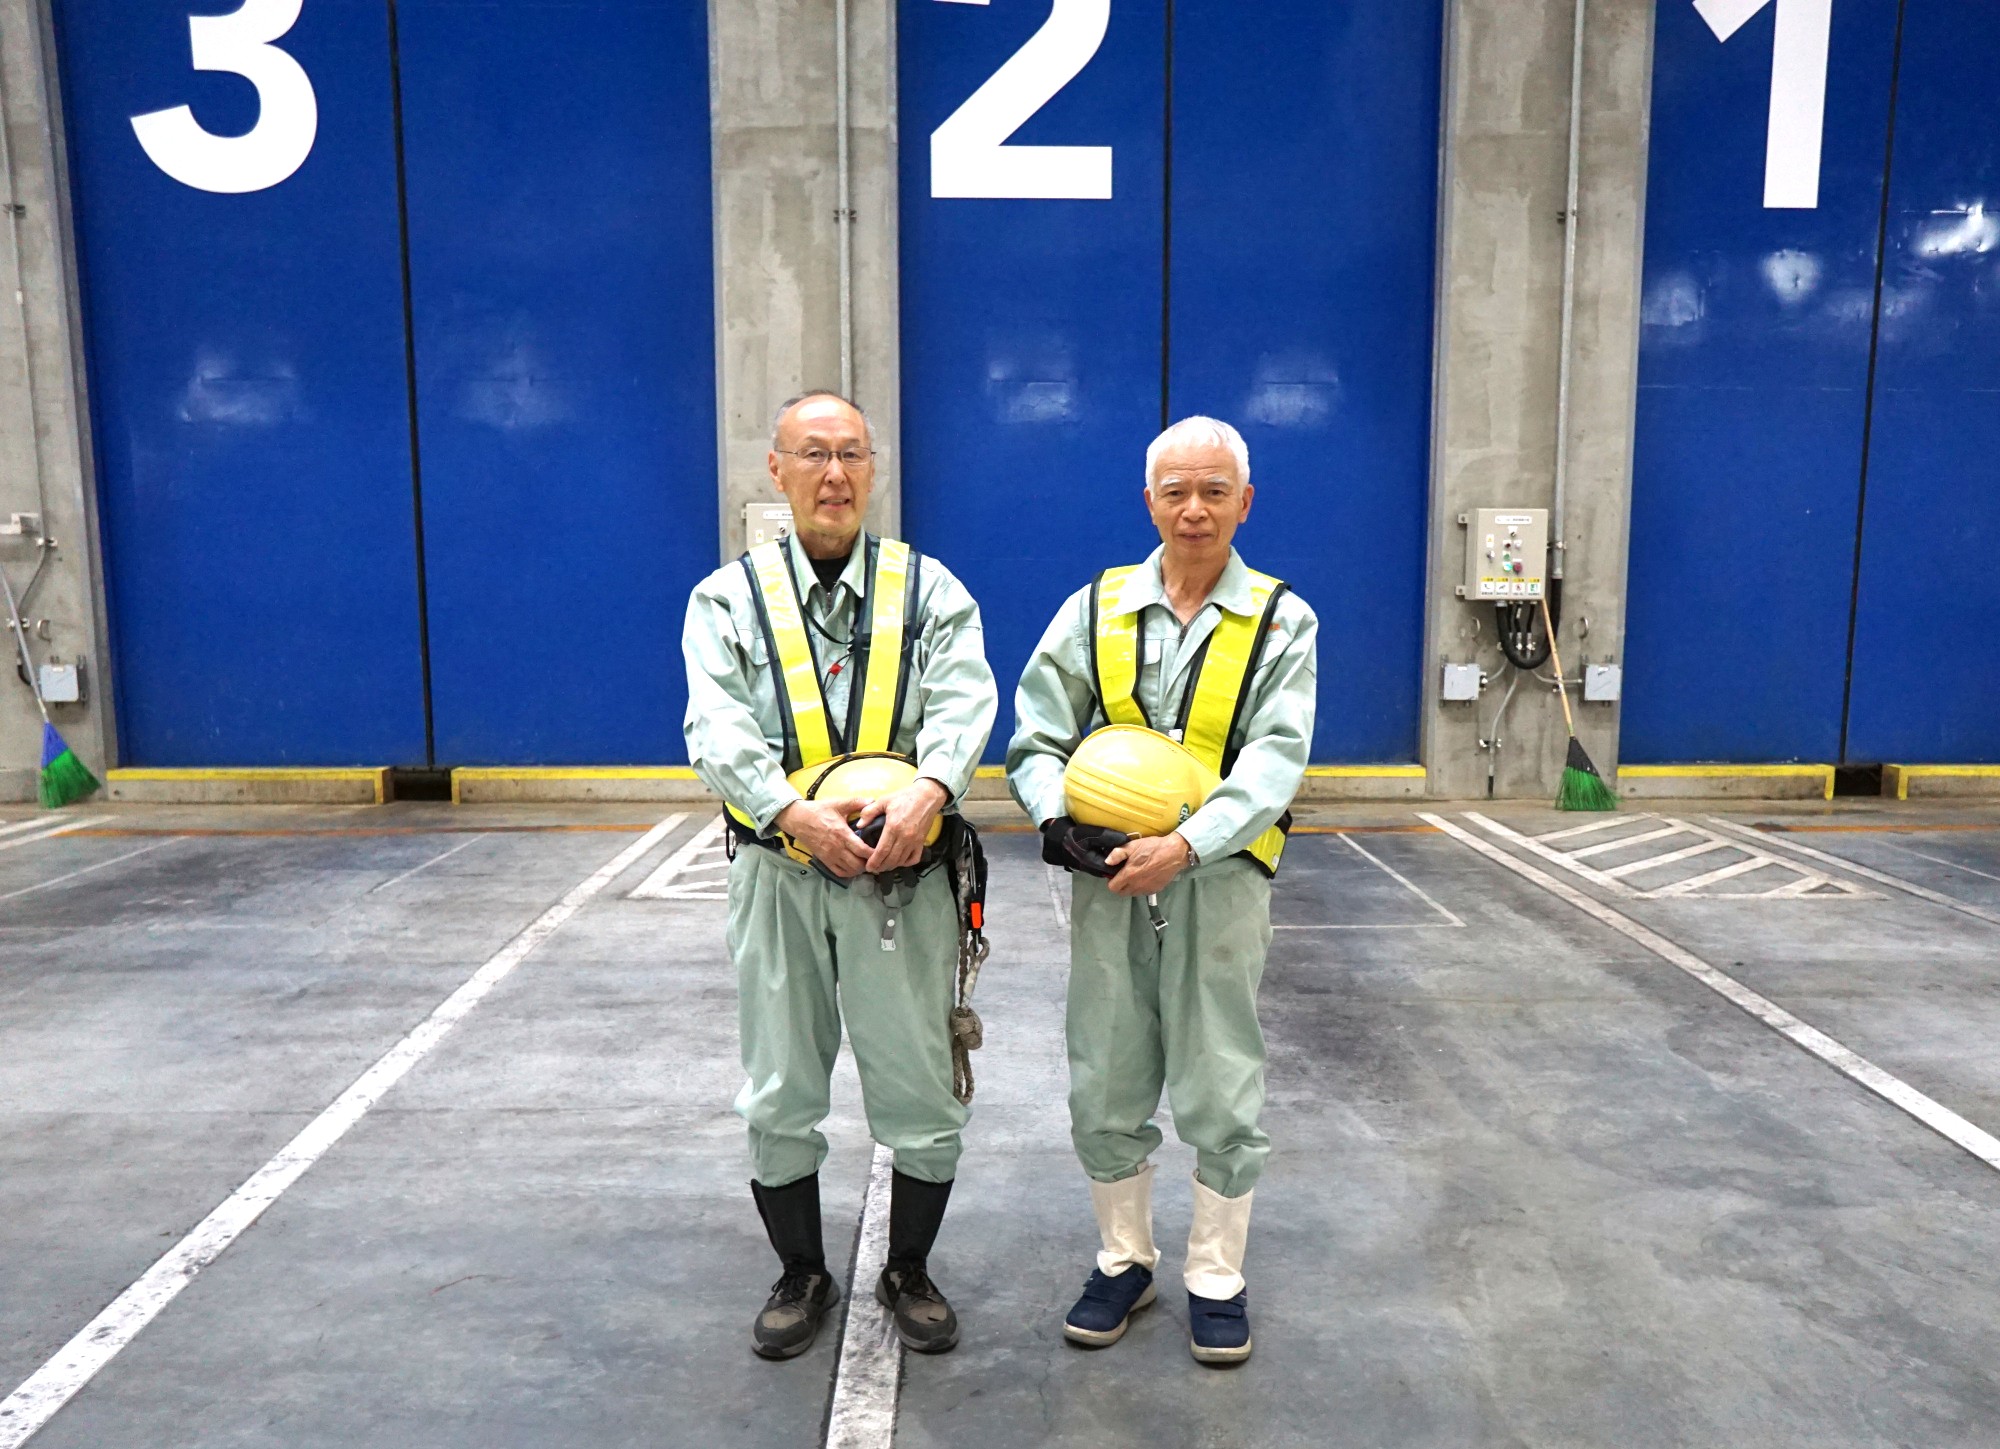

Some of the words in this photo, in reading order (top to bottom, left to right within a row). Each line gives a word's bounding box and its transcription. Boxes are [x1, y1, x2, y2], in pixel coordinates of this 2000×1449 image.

[131, 0, 317, 194] 3
[931, 0, 1112, 200] 2
[1693, 0, 1832, 209] 1
